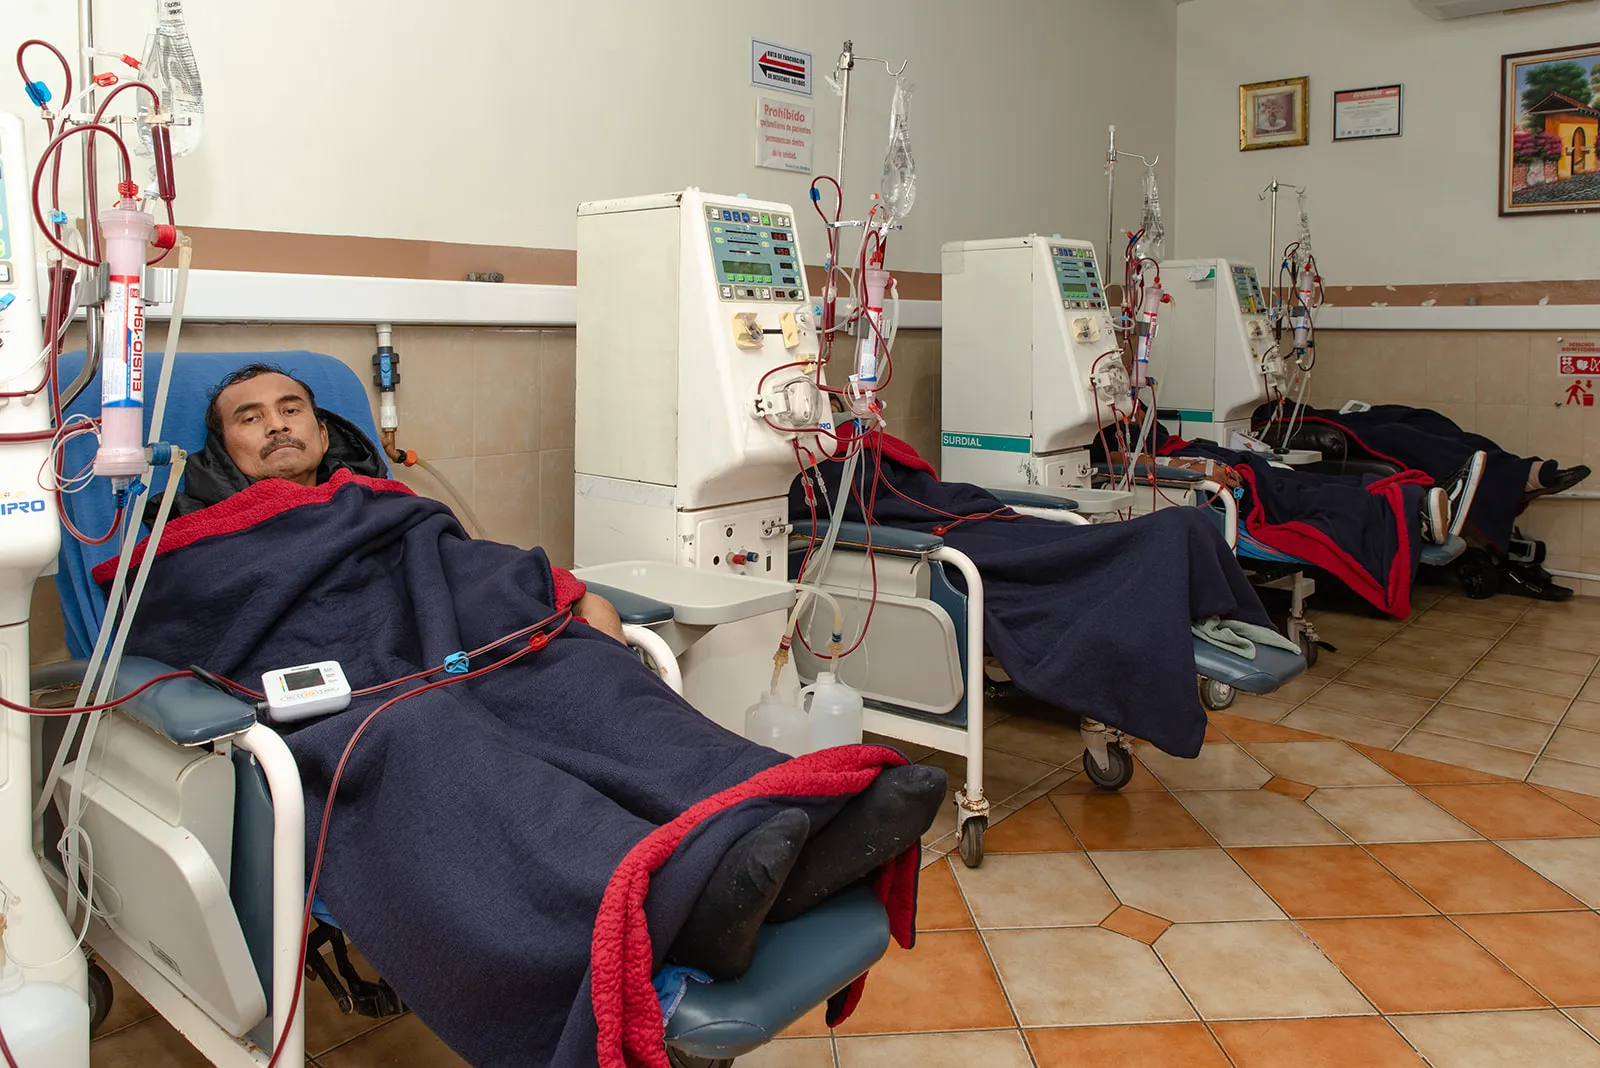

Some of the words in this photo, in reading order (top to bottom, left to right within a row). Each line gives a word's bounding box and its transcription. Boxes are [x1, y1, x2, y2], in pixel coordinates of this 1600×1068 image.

[764, 104, 805, 122] Prohibido
[132, 306, 144, 391] ELISIO-19H
[943, 435, 982, 446] SURDIAL
[1, 500, 45, 515] IPRO
